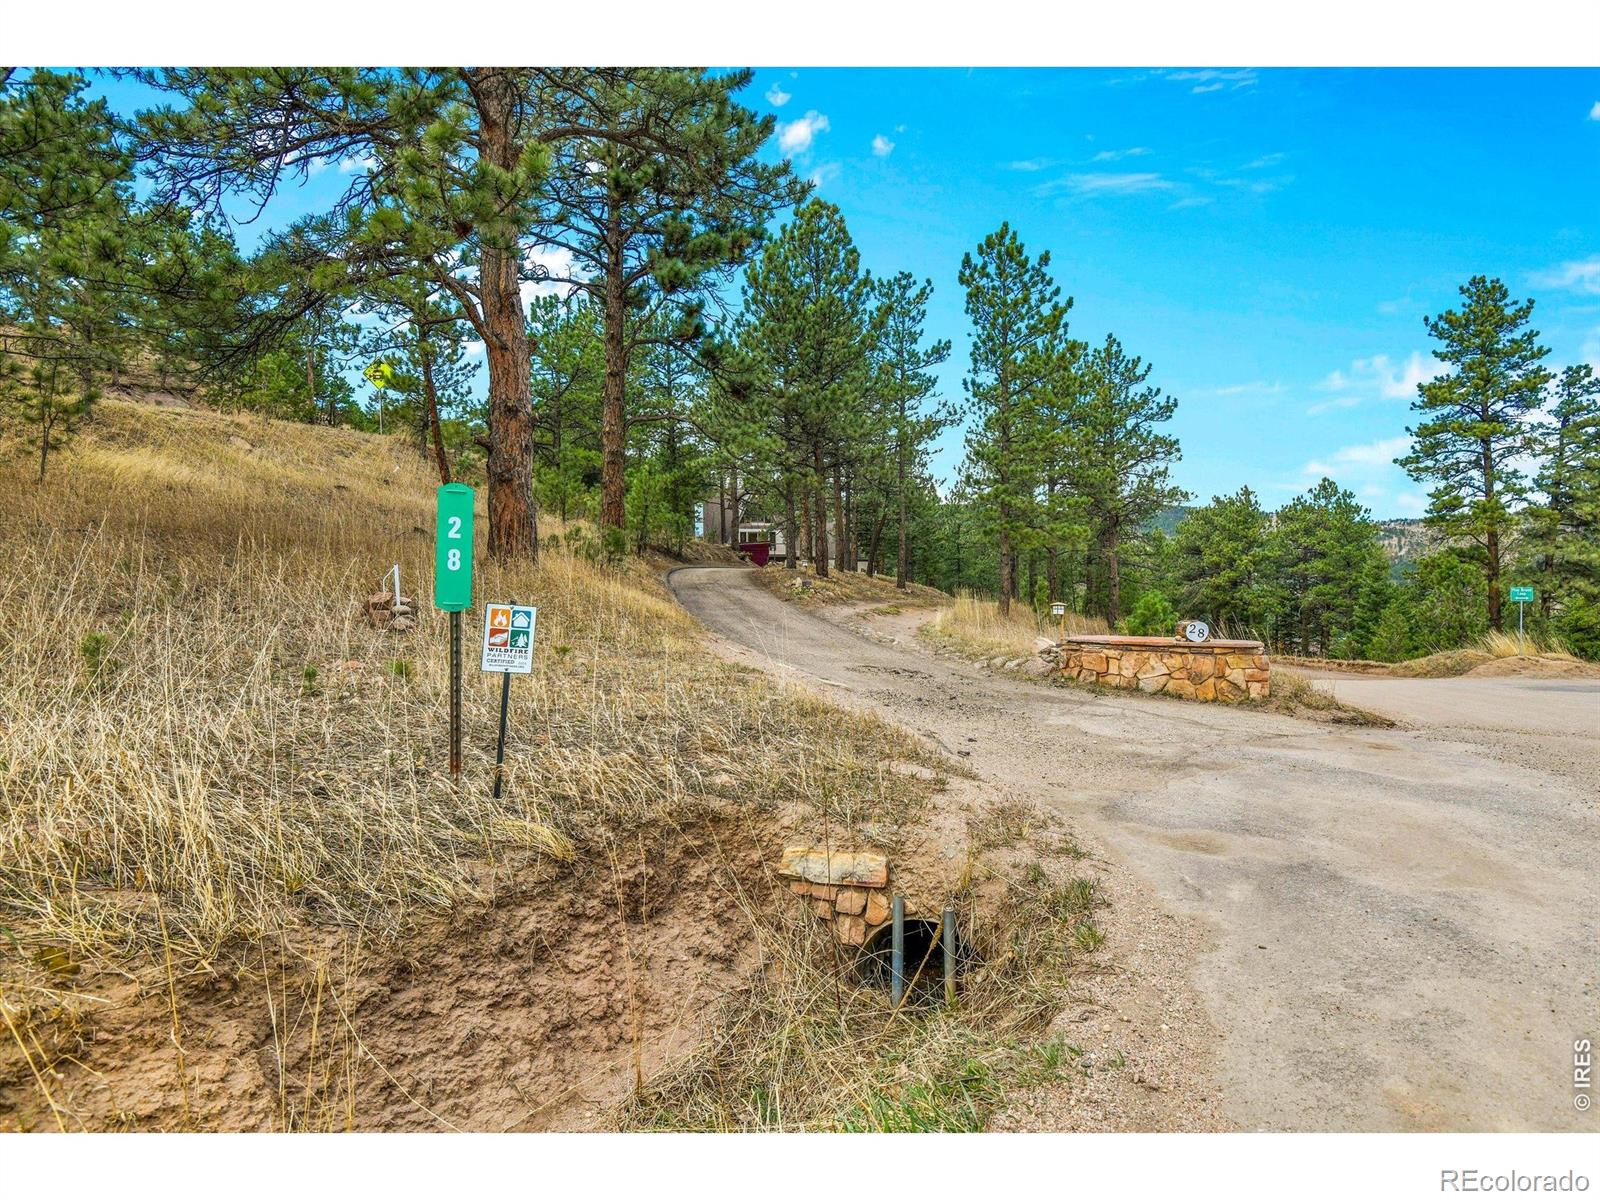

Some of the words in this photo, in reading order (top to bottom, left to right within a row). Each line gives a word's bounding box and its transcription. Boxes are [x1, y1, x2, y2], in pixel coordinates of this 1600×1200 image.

[1189, 623, 1205, 638] 28
[487, 647, 529, 655] WILDFIRE
[486, 652, 529, 660] PARTNERS
